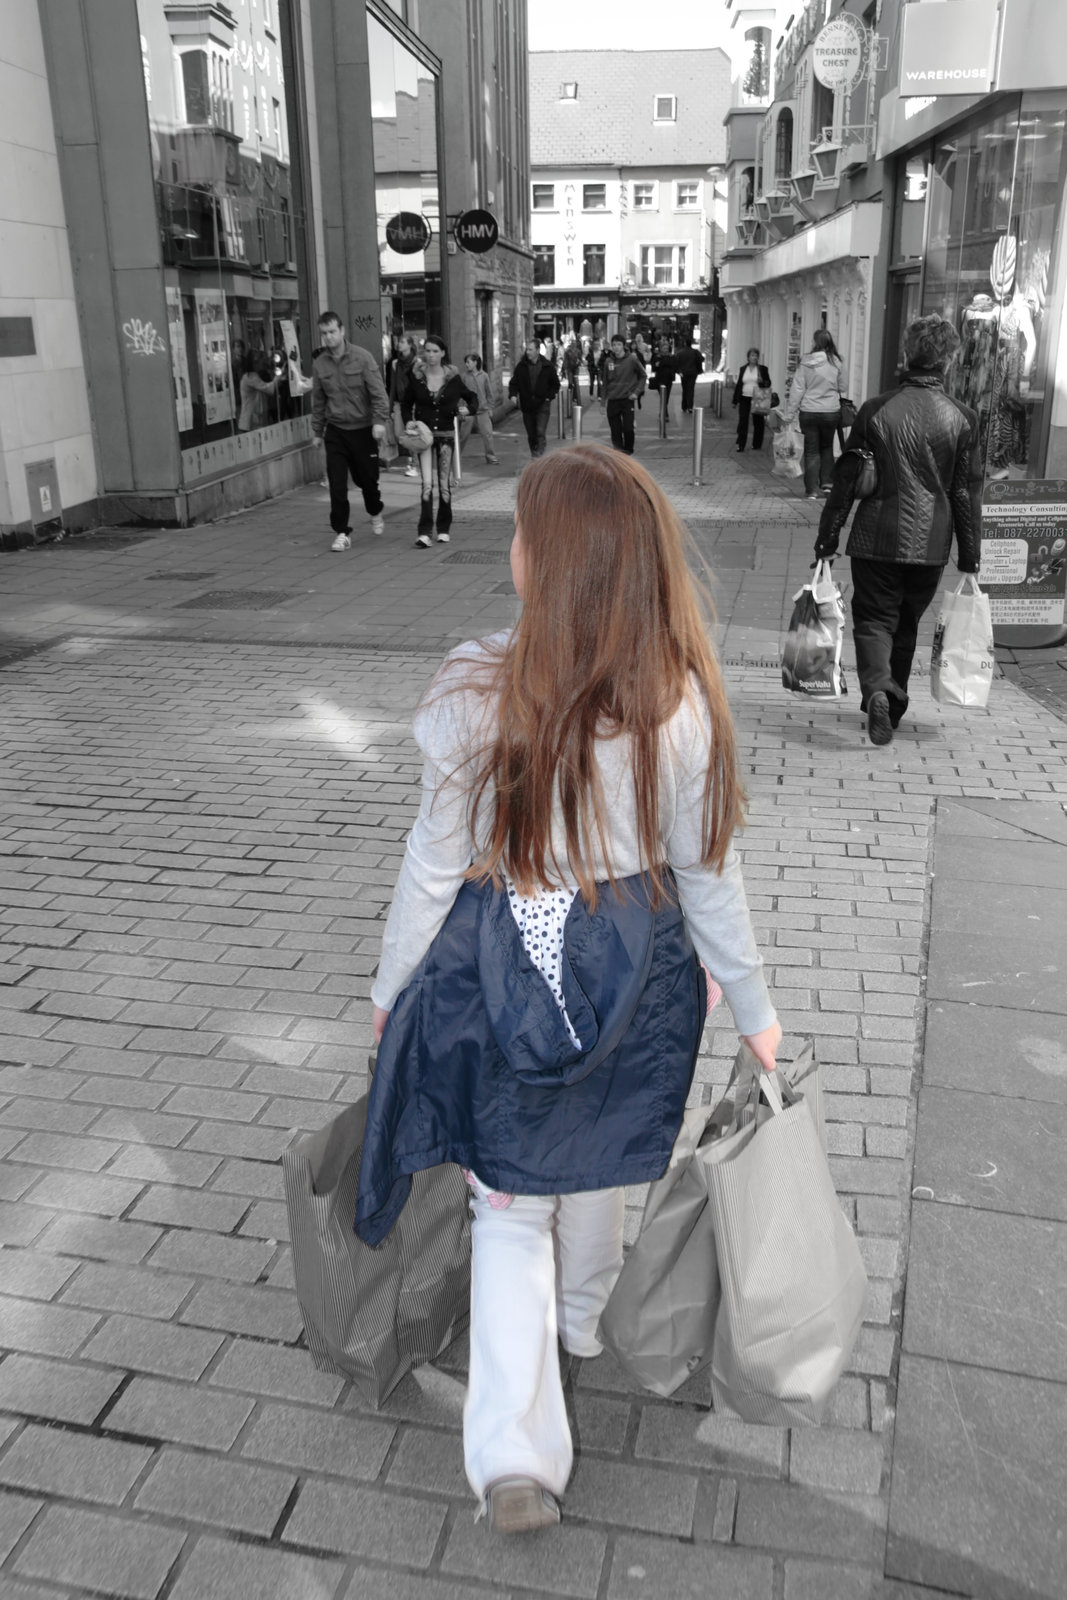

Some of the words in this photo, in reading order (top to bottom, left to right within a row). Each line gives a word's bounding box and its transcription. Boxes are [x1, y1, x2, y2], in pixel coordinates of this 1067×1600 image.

[815, 48, 858, 56] TREASURE
[822, 59, 849, 67] CHEST
[906, 68, 987, 81] WAREHOUSE
[461, 224, 495, 239] HMV
[986, 506, 1027, 514] Technology
[983, 528, 1001, 538] Tel:
